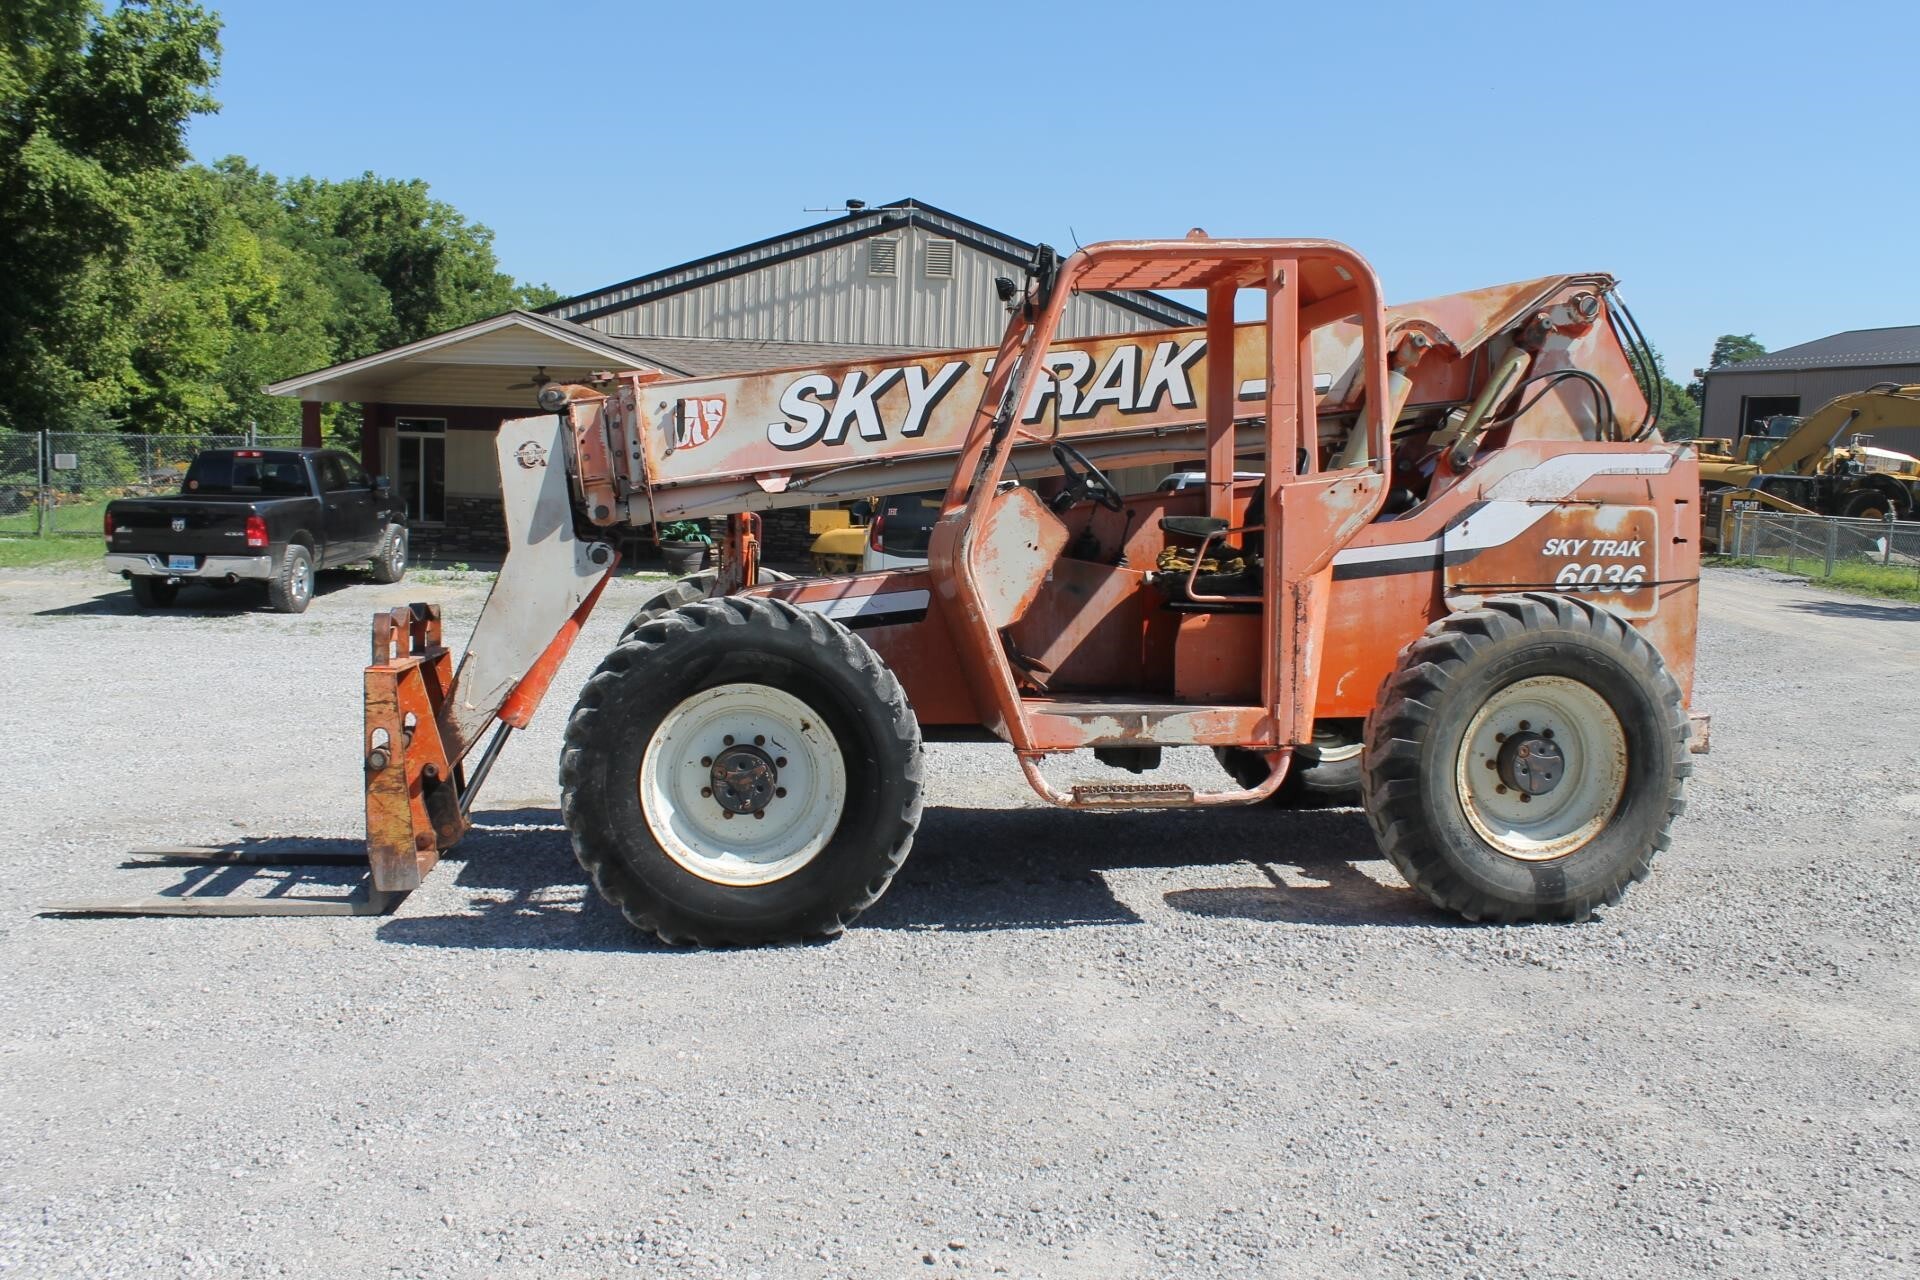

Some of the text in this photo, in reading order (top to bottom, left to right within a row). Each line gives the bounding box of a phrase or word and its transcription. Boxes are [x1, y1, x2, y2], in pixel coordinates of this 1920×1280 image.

[768, 341, 1207, 451] SKY RAK
[1542, 538, 1646, 557] SKY TRAK
[1554, 563, 1647, 594] 6036
